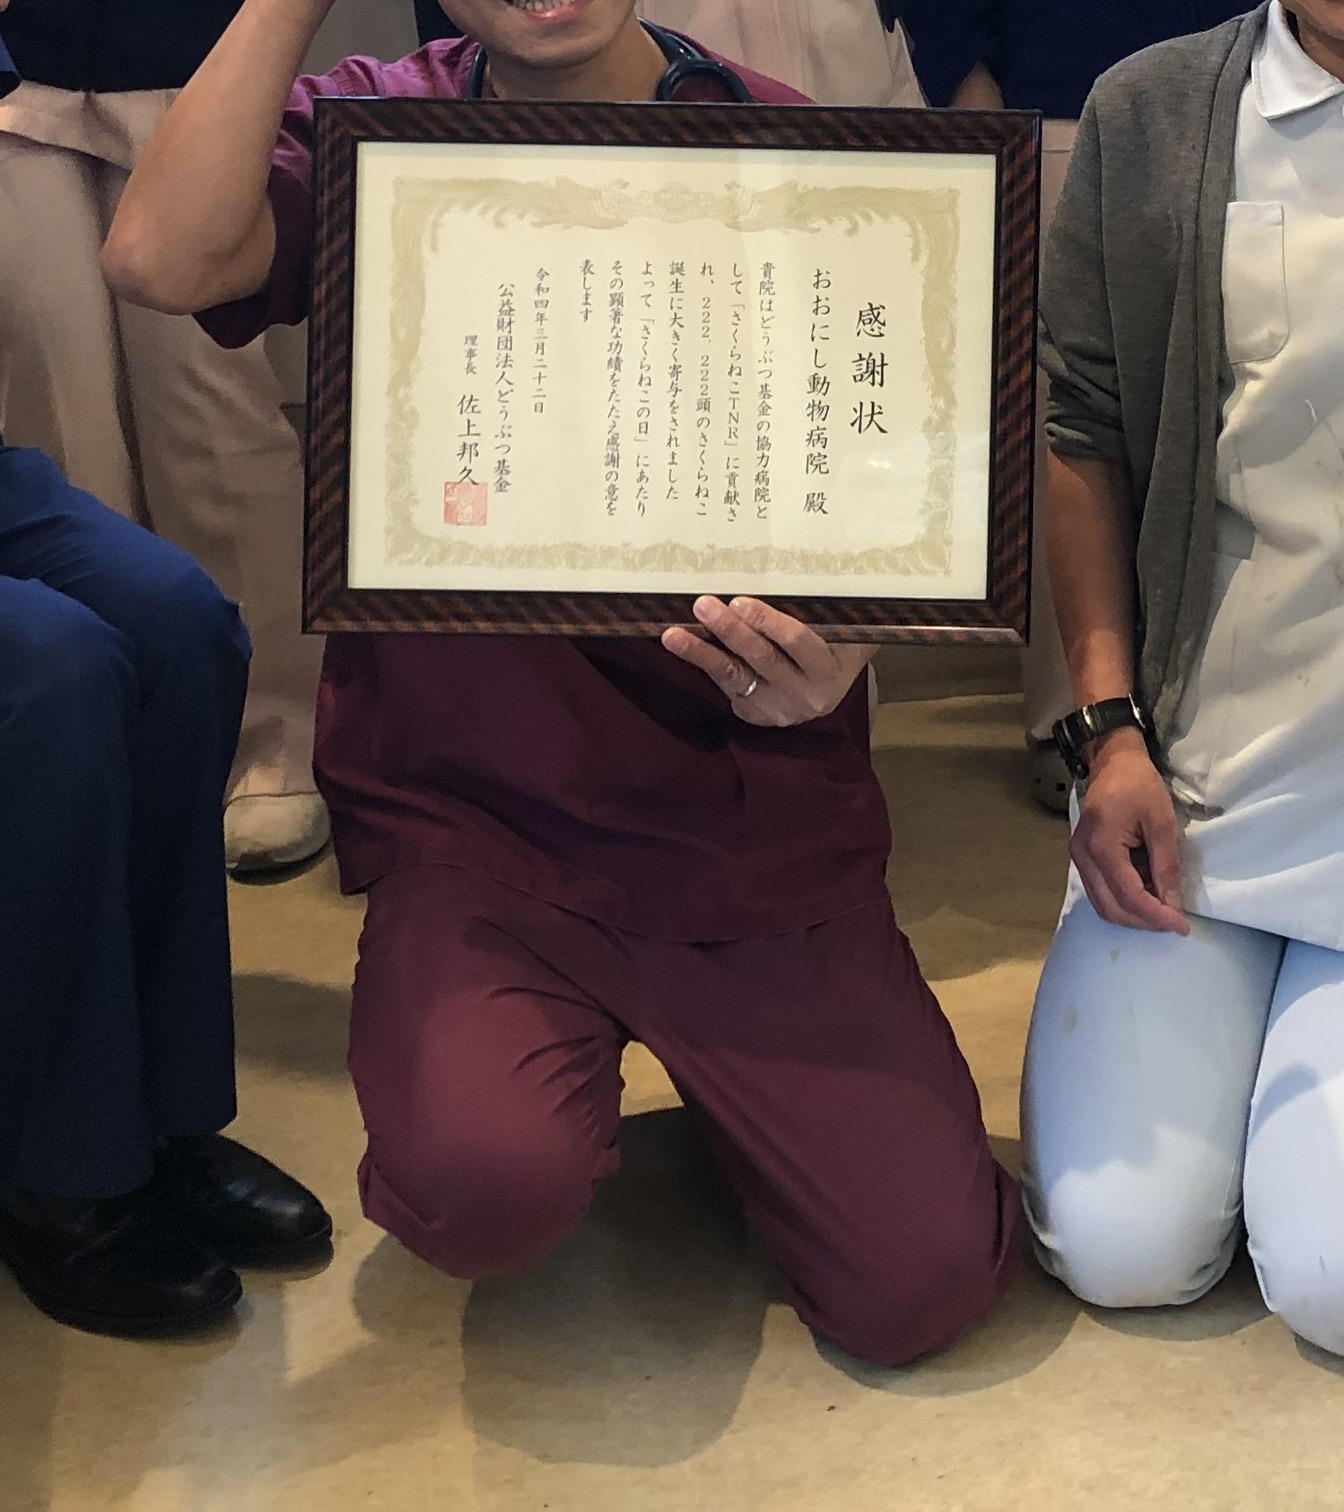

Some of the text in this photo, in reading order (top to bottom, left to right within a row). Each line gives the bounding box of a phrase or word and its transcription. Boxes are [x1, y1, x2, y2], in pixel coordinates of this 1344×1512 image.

[463, 334, 478, 375] 理事長
[493, 282, 516, 494] 公益財団法人どうぶつ基金
[531, 267, 550, 414] 令和四年三月二十二日
[579, 259, 595, 323] 表します
[604, 260, 624, 517] その顕著な功績をたたえ感謝の意を
[666, 261, 686, 500] 誕生に大きく寄与をされました
[723, 262, 745, 522] して「さくらねこTNR」に貢献さ
[754, 262, 775, 519] 貴院はどうぶつ基金の協力病院と
[803, 268, 831, 515] おおにし動物病院 殿
[850, 301, 888, 434] 感謝状
[456, 394, 482, 486] 佐上邦久
